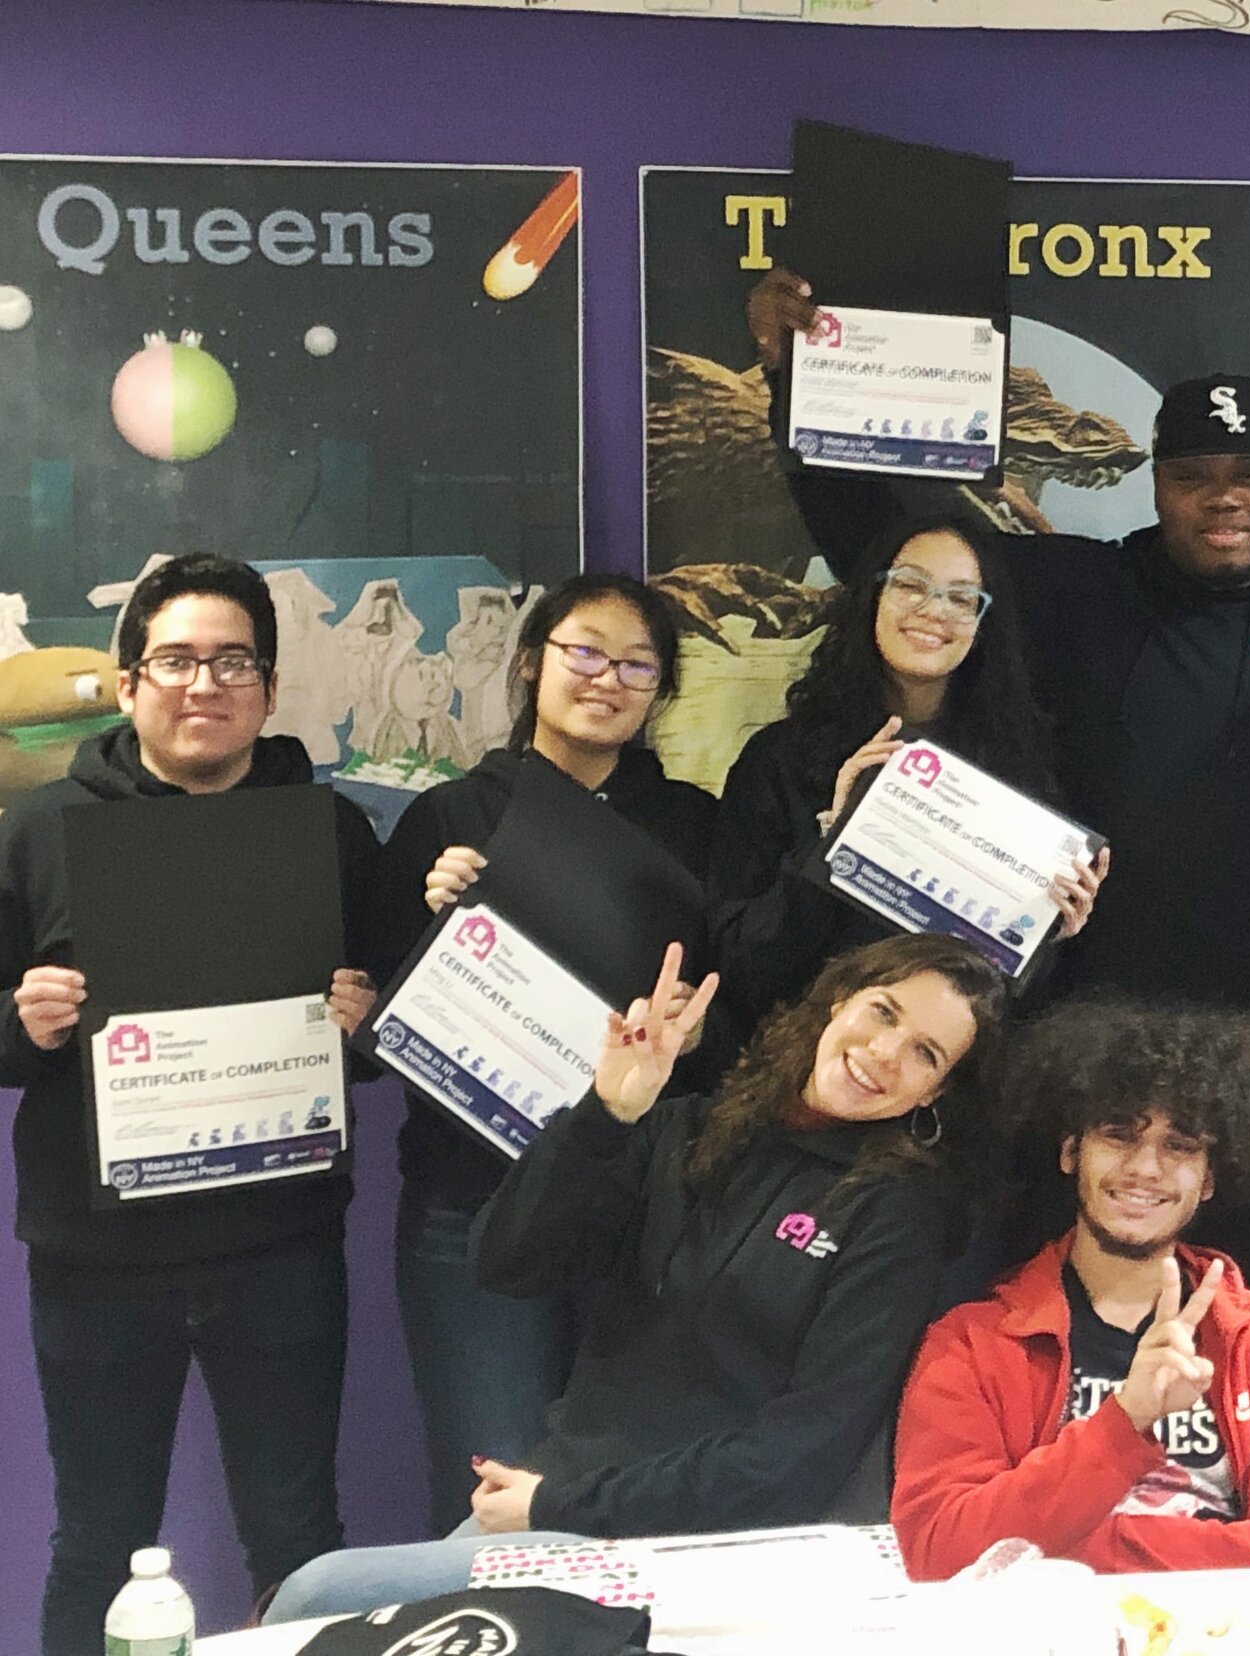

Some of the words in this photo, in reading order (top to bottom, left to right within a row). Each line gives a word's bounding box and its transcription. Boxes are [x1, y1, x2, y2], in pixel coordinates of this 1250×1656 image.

[38, 184, 434, 275] Queens
[725, 195, 787, 270] T
[1009, 222, 1212, 278] ronx
[801, 357, 885, 377] CERTIFICATE
[899, 365, 992, 384] COMPLETION
[883, 782, 962, 835] CERTIFICATE
[972, 836, 1053, 890] COMPLETIO
[438, 951, 512, 1012] CERTIFICATE
[109, 1069, 207, 1091] CERTIFICATE
[226, 1053, 331, 1078] COMPLETION
[407, 1036, 433, 1060] Made
[1153, 1409, 1220, 1455] ES
